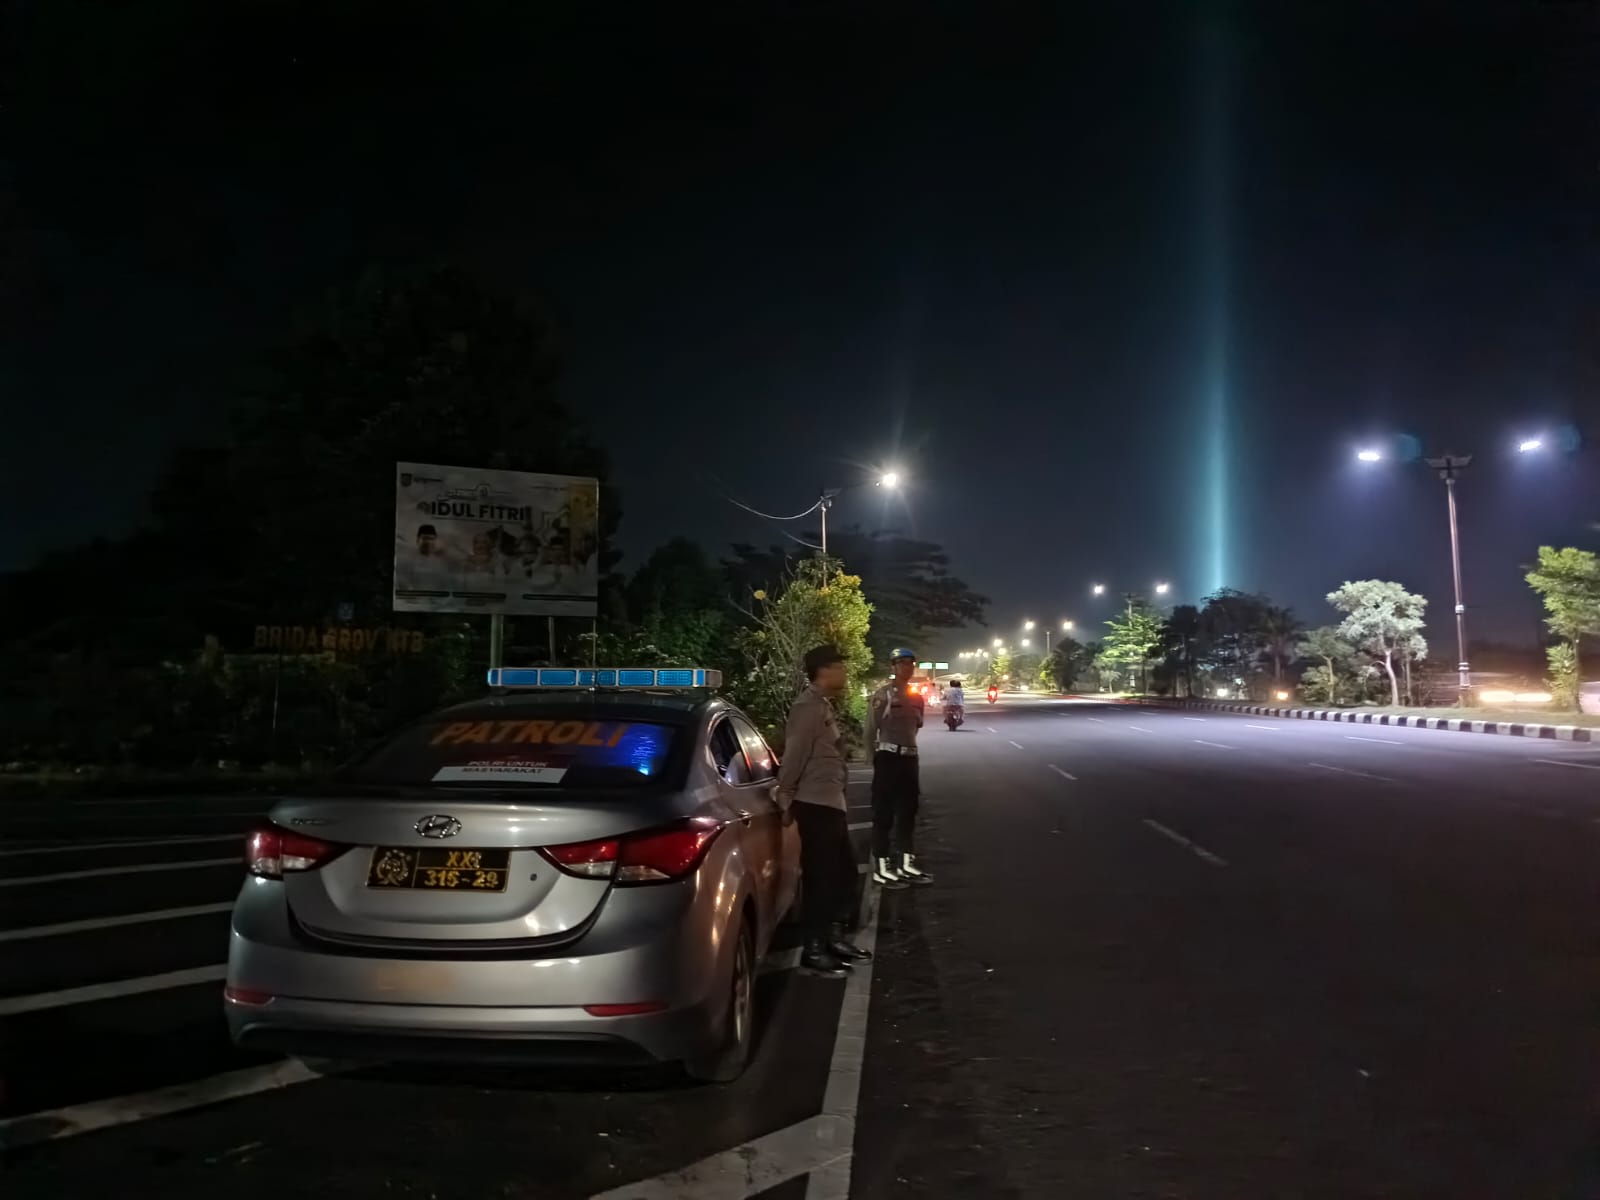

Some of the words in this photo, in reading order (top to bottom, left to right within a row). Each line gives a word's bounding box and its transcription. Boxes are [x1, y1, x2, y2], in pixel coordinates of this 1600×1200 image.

[431, 502, 475, 518] IDUL
[479, 505, 524, 520] FITRI
[430, 720, 628, 747] PATROLI
